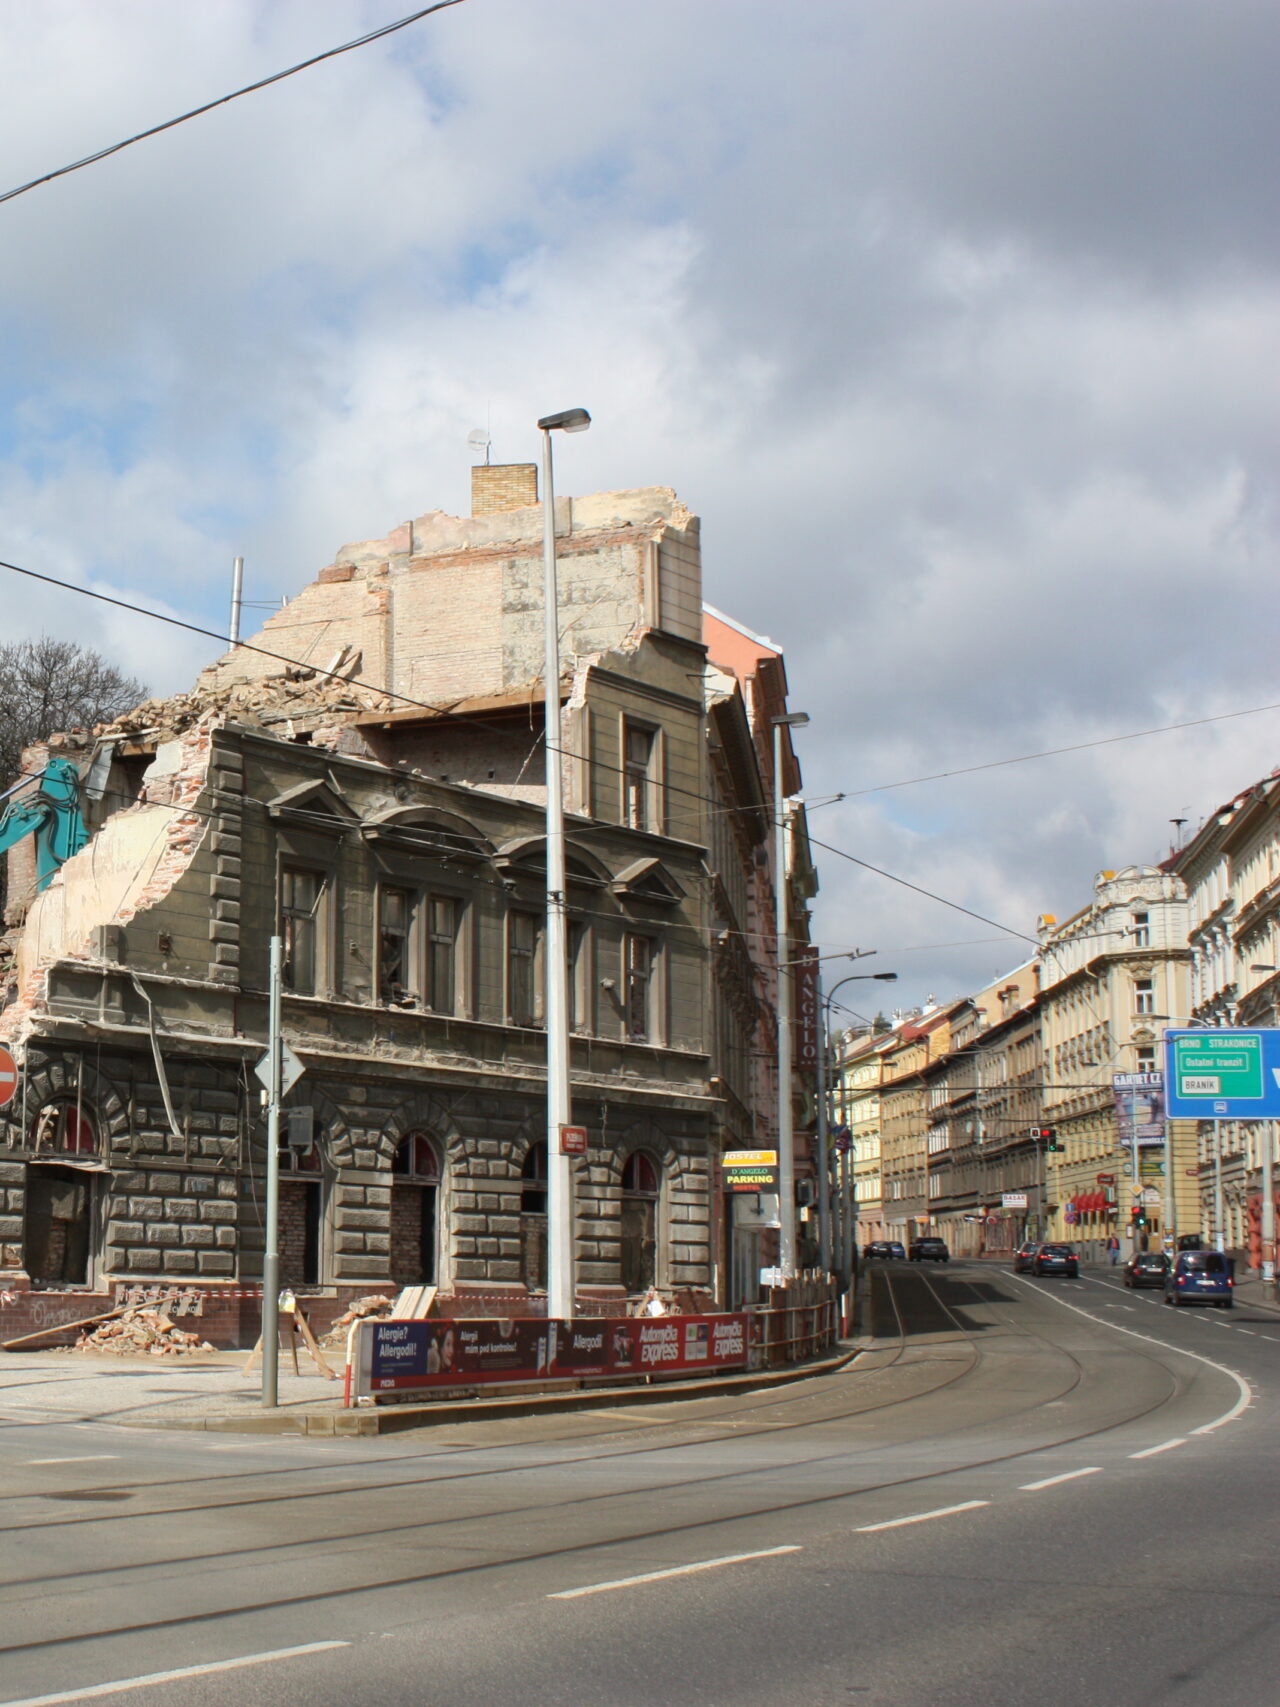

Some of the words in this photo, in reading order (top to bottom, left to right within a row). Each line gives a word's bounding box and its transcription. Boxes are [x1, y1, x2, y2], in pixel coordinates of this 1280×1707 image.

[1179, 1038, 1202, 1049] BRNO
[1208, 1038, 1258, 1049] STRAKONICE
[1185, 1057, 1214, 1067] Ostatní
[1216, 1057, 1244, 1067] tranzit
[1185, 1079, 1215, 1090] BRANÍK
[727, 1175, 774, 1184] PARKING
[378, 1325, 408, 1343] Alergie?
[639, 1324, 679, 1344] Automyčka
[379, 1343, 417, 1360] Allergodil!
